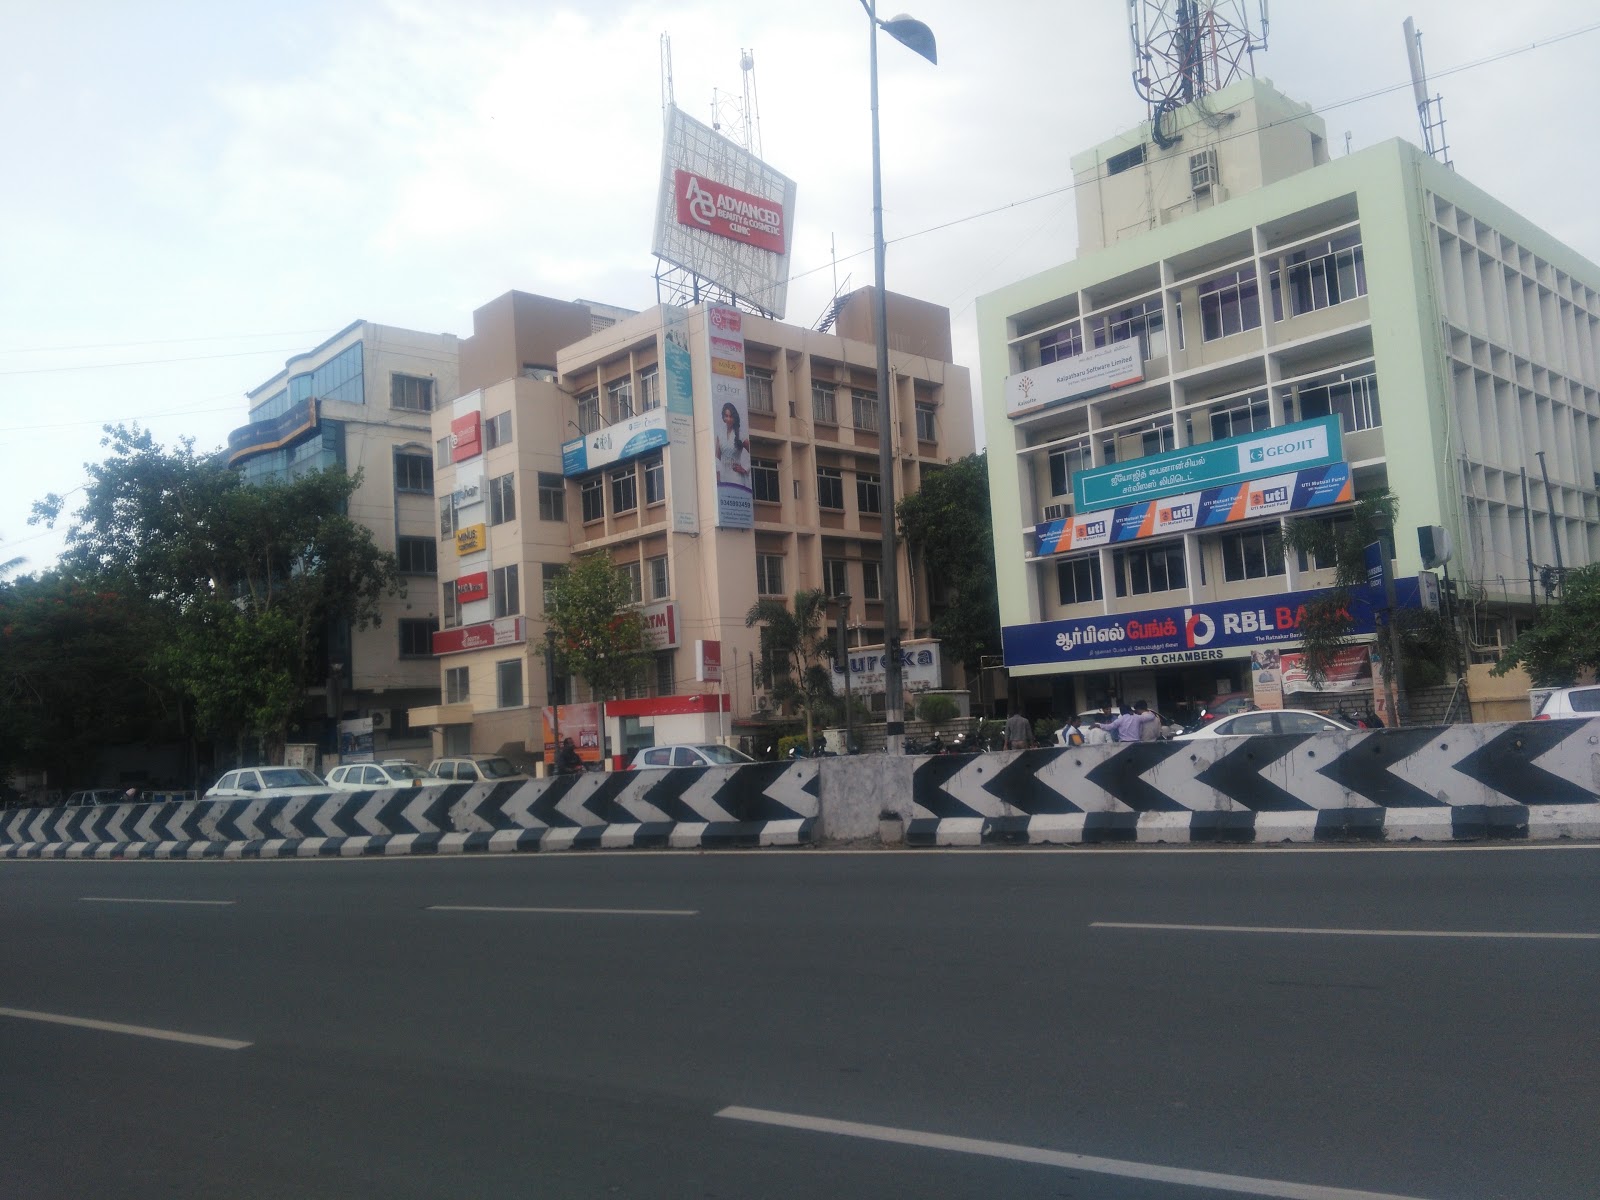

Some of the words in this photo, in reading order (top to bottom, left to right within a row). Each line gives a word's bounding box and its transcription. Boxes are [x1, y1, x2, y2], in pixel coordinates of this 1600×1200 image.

[716, 194, 780, 226] ADVANCED
[717, 209, 743, 224] BEAUTY
[749, 219, 780, 236] COSMETIC
[729, 222, 751, 236] CLINIC
[1086, 363, 1110, 374] Software
[1111, 355, 1133, 367] Limited
[1266, 438, 1315, 457] GEOJIT
[1311, 478, 1330, 487] Mutual
[1212, 498, 1230, 506] Mutual
[1265, 488, 1285, 503] uti
[1173, 505, 1191, 519] uti
[1087, 521, 1104, 535] uti
[642, 613, 667, 630] ATM
[1223, 609, 1274, 635] RBL
[1275, 604, 1354, 631] BA
[1265, 633, 1289, 641] Ratnakar
[1162, 649, 1223, 663] CHAMBERS
